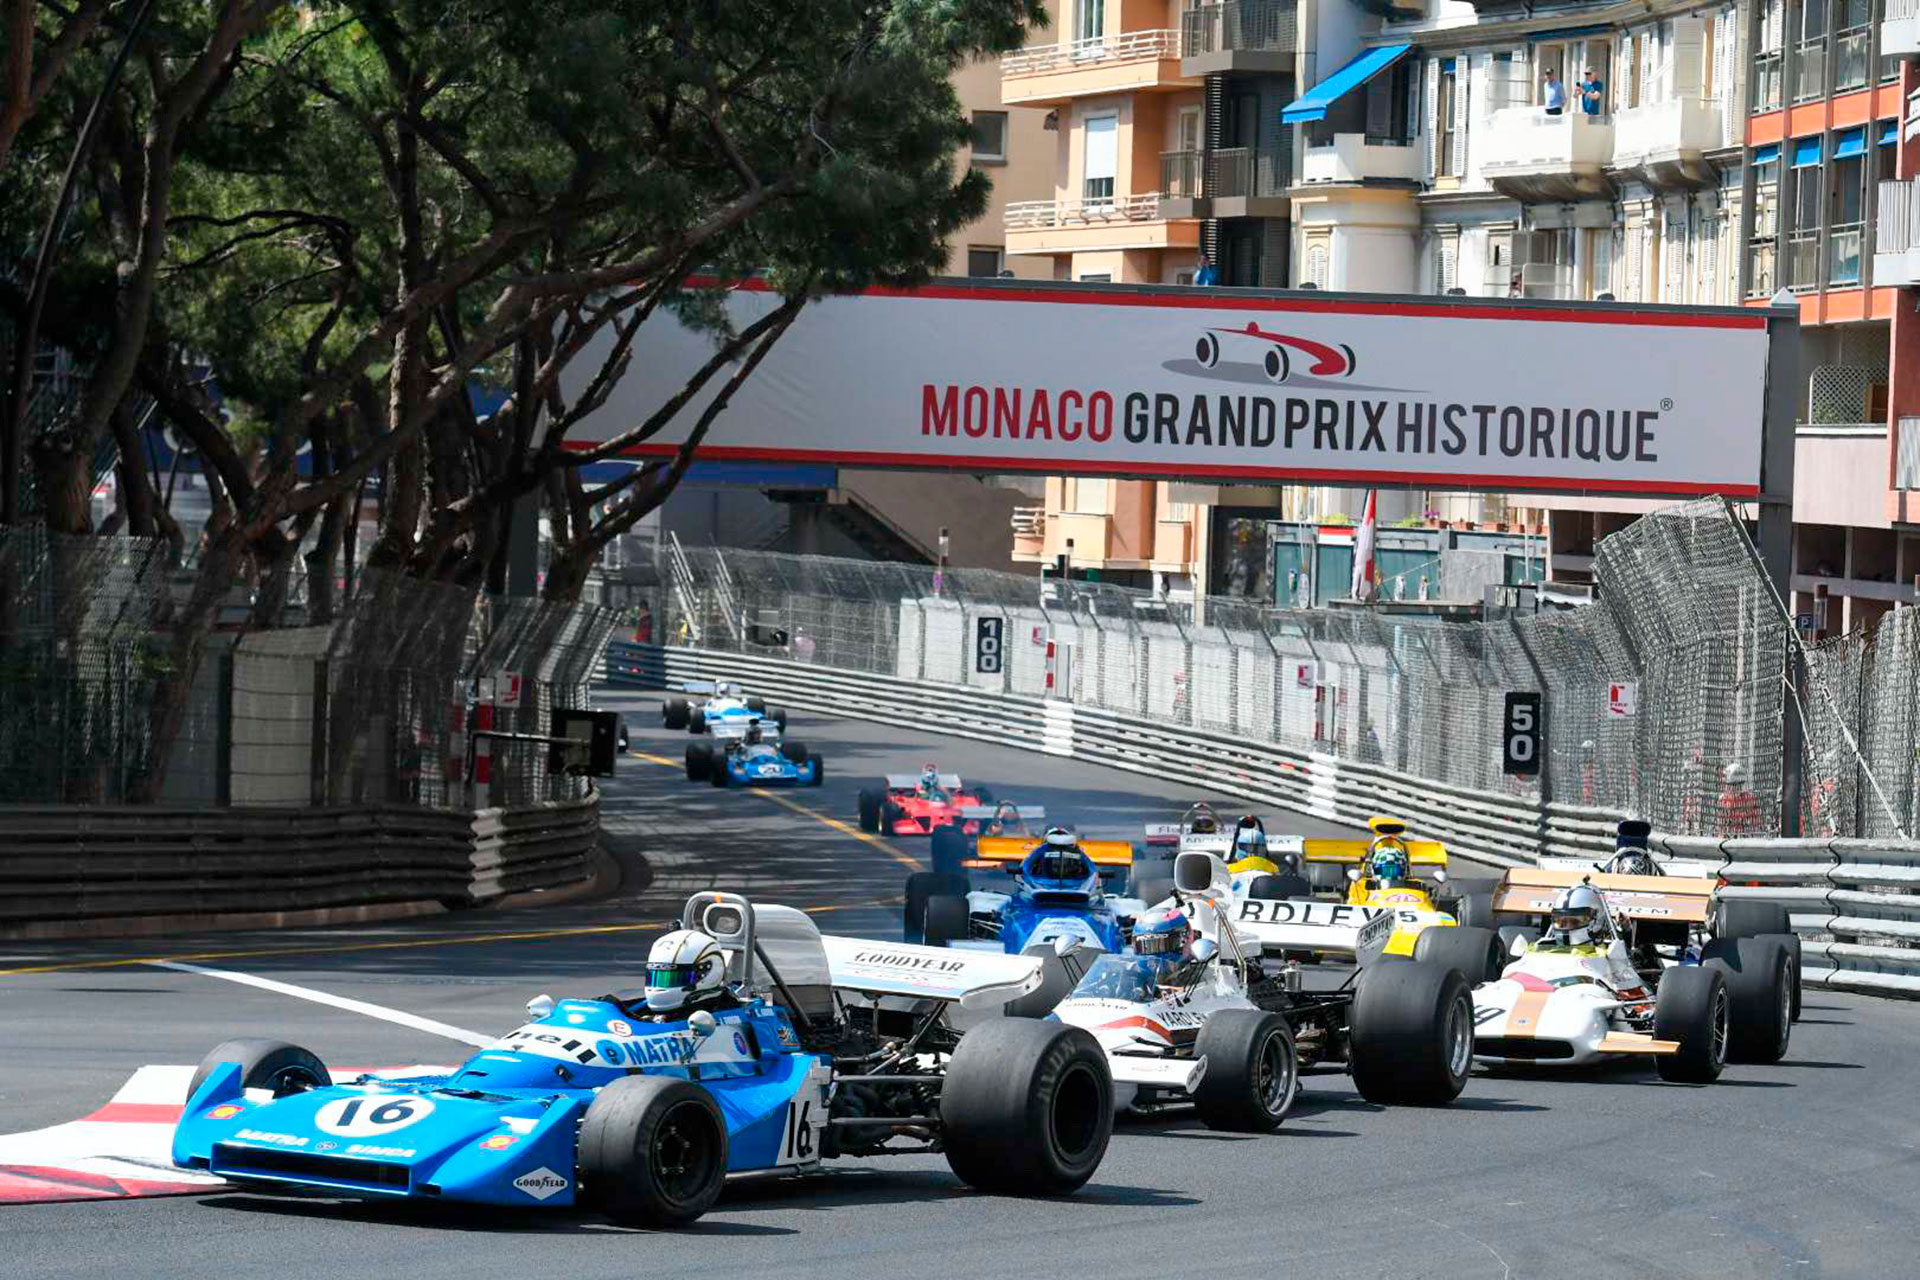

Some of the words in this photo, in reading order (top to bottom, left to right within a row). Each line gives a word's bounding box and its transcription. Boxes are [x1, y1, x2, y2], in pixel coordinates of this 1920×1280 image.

[922, 384, 1114, 443] MONACO
[1124, 392, 1276, 449] GRAND
[1284, 398, 1388, 452] PRIX
[1397, 401, 1660, 463] HISTORIQUE
[983, 620, 998, 671] 100
[1510, 704, 1533, 761] 50
[855, 952, 965, 972] GOODYEAR
[622, 1038, 698, 1066] MATRA
[336, 1100, 416, 1127] 16
[787, 1100, 812, 1158] 16
[235, 1129, 309, 1146] MATRA
